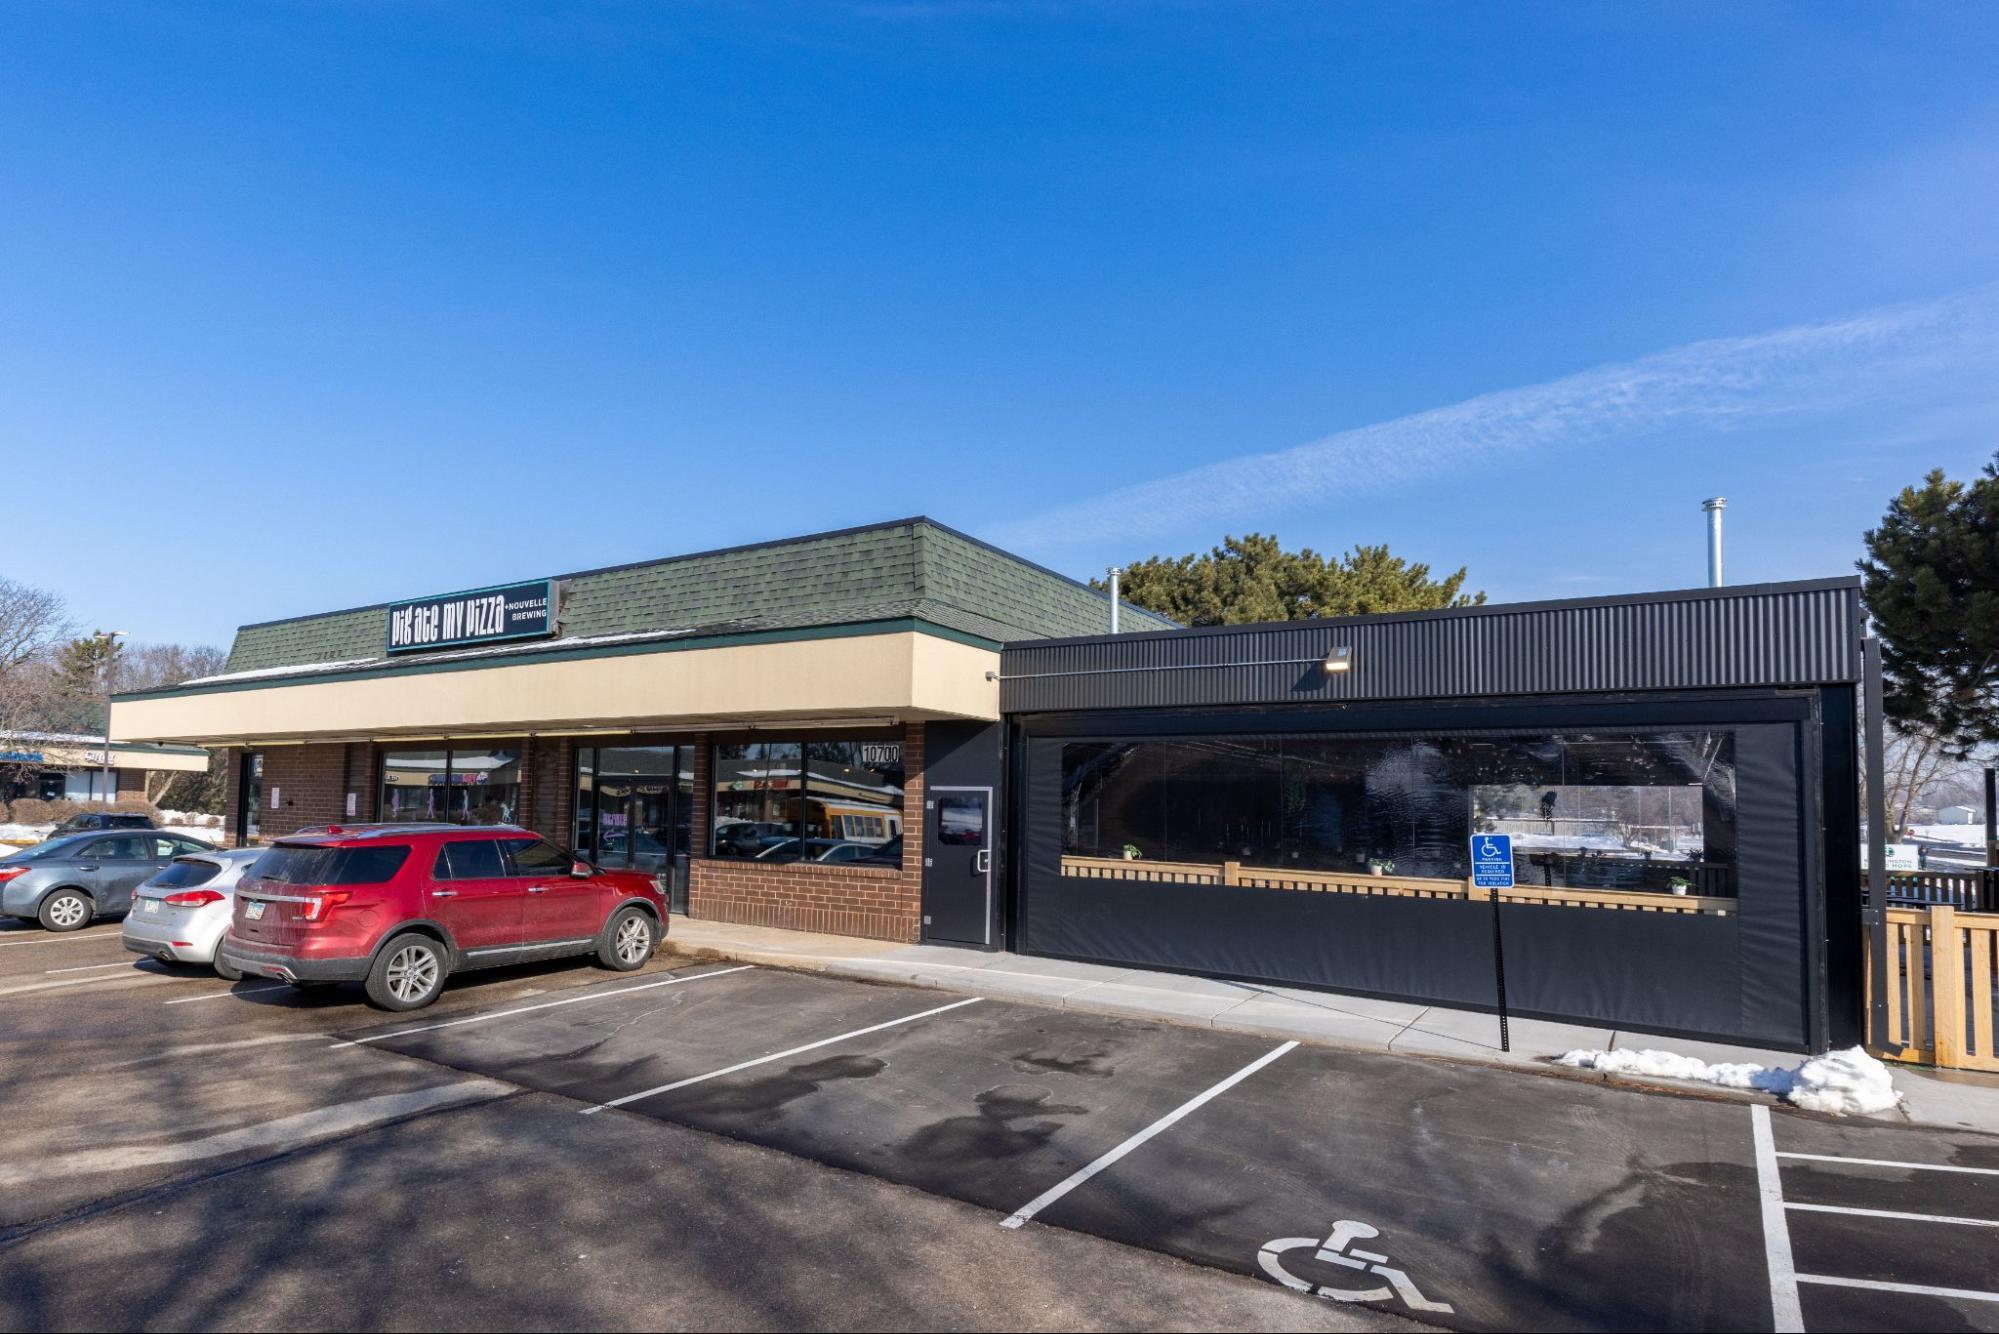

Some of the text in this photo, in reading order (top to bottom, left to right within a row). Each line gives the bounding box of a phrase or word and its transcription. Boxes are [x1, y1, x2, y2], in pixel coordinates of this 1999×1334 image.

[414, 604, 439, 643] ate
[465, 594, 505, 636] pizza
[511, 609, 547, 621] BREWING
[864, 745, 898, 762] 10700
